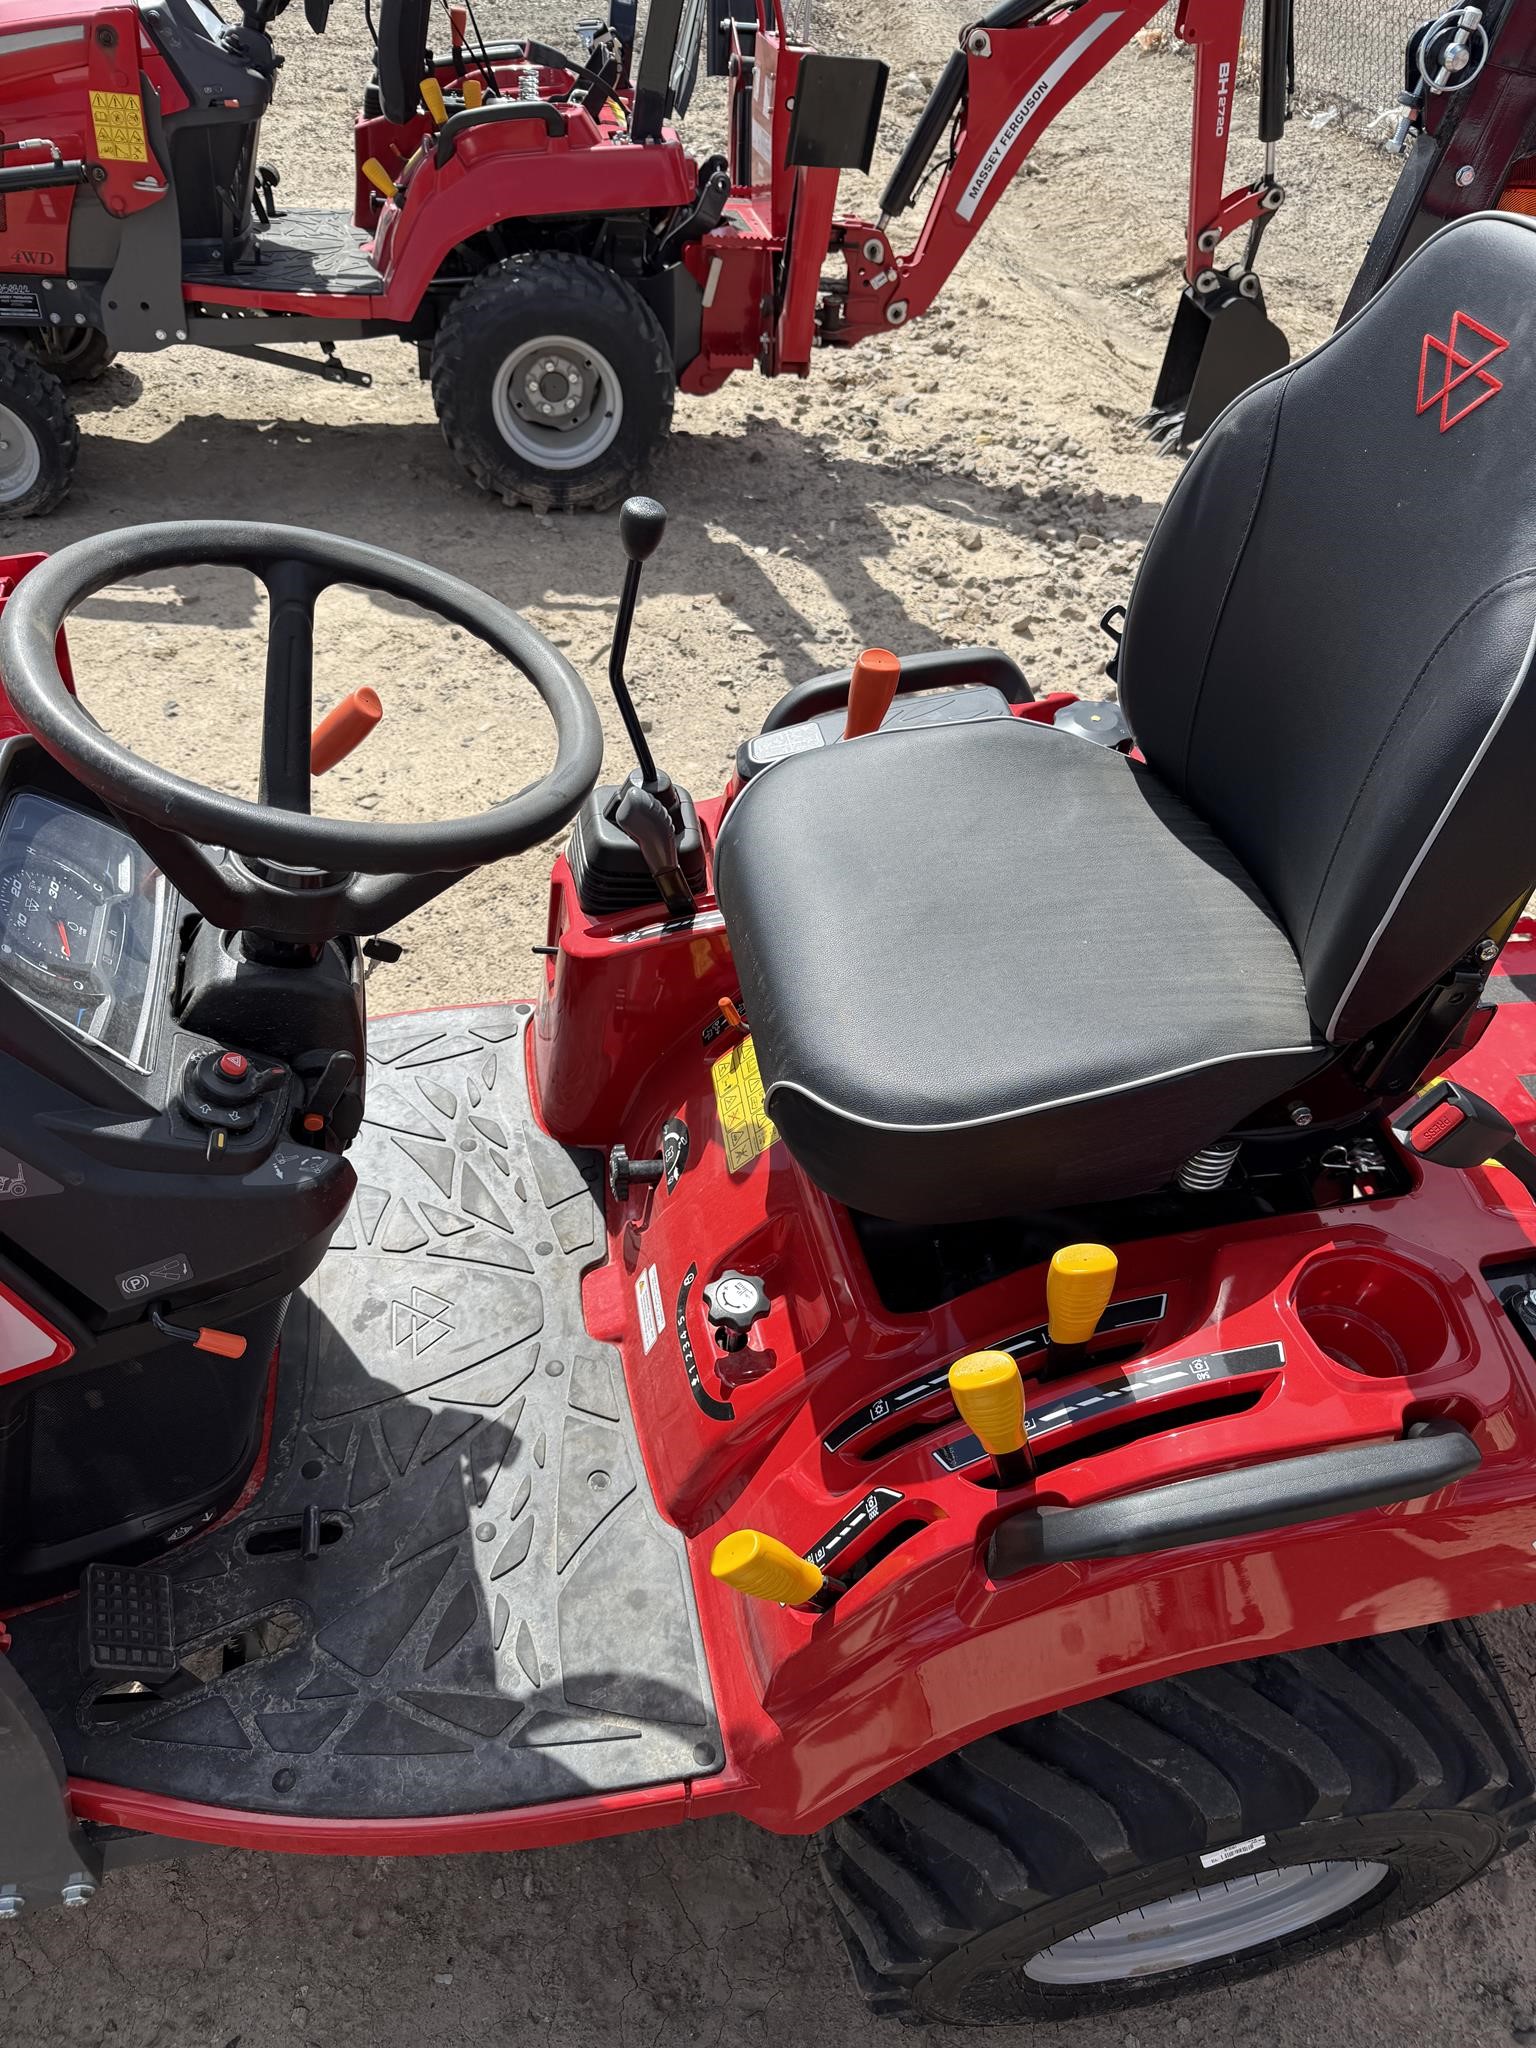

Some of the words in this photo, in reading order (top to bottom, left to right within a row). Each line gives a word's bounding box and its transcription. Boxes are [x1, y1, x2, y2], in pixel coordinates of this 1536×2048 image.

[969, 147, 1002, 199] MASSEY
[1000, 81, 1048, 146] FERGUSON
[10, 248, 54, 265] 4WD
[26, 846, 37, 855] H
[11, 879, 22, 898] 20
[48, 881, 60, 899] 30
[93, 883, 103, 892] C
[17, 913, 27, 927] 10
[1423, 1116, 1450, 1140] PRESS
[130, 1278, 140, 1290] P
[677, 1315, 686, 1326] 5
[679, 1330, 687, 1339] 4
[682, 1341, 691, 1352] 3
[685, 1352, 693, 1362] 2
[688, 1364, 696, 1374] 1
[1196, 1371, 1211, 1381] 540
